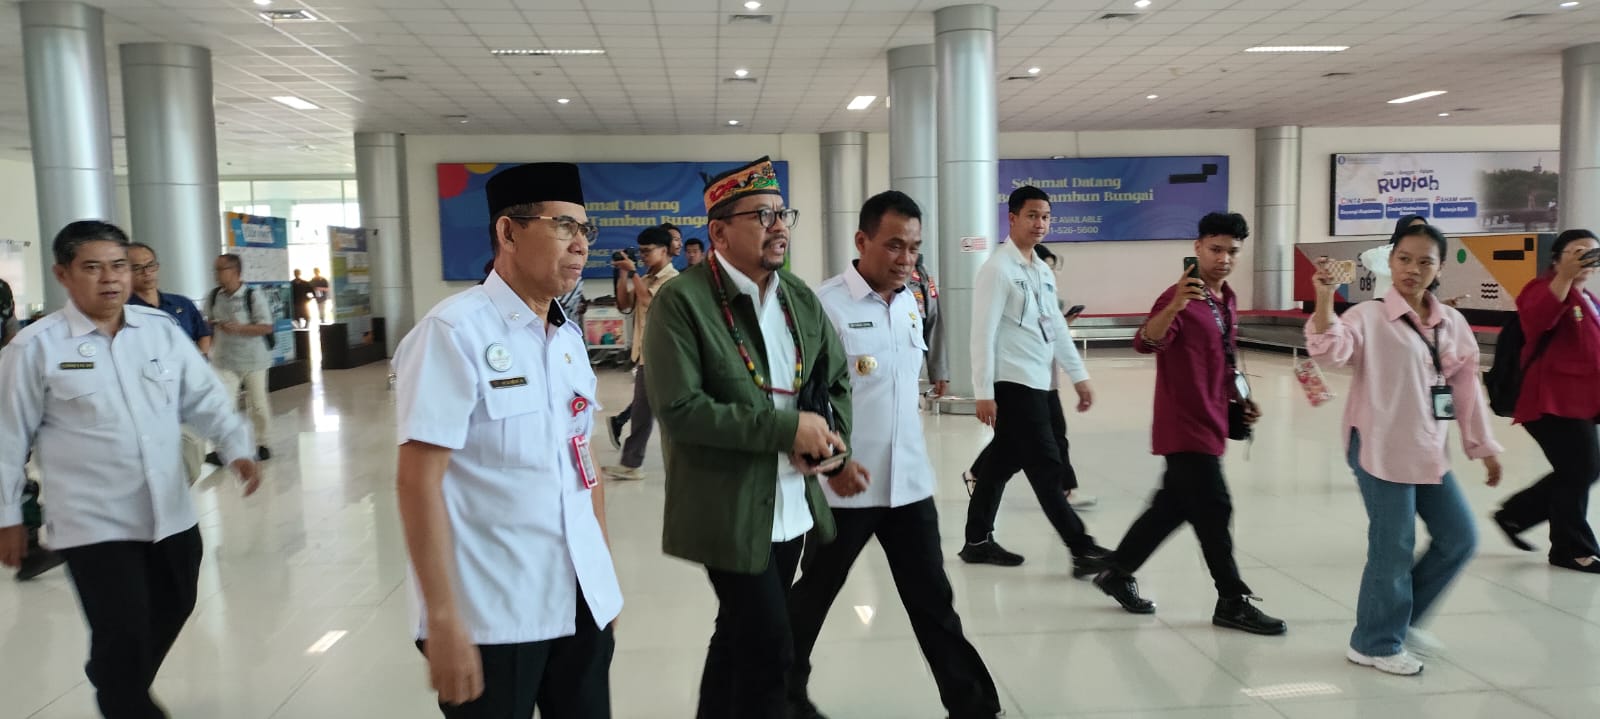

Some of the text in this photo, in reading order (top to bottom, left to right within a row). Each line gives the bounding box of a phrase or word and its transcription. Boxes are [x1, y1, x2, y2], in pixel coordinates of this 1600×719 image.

[1071, 177, 1121, 190] Datang
[1377, 175, 1440, 194] Rupiah
[1047, 188, 1154, 204] ambun Bungai
[624, 200, 679, 212] Datang
[661, 215, 708, 229] Bunga
